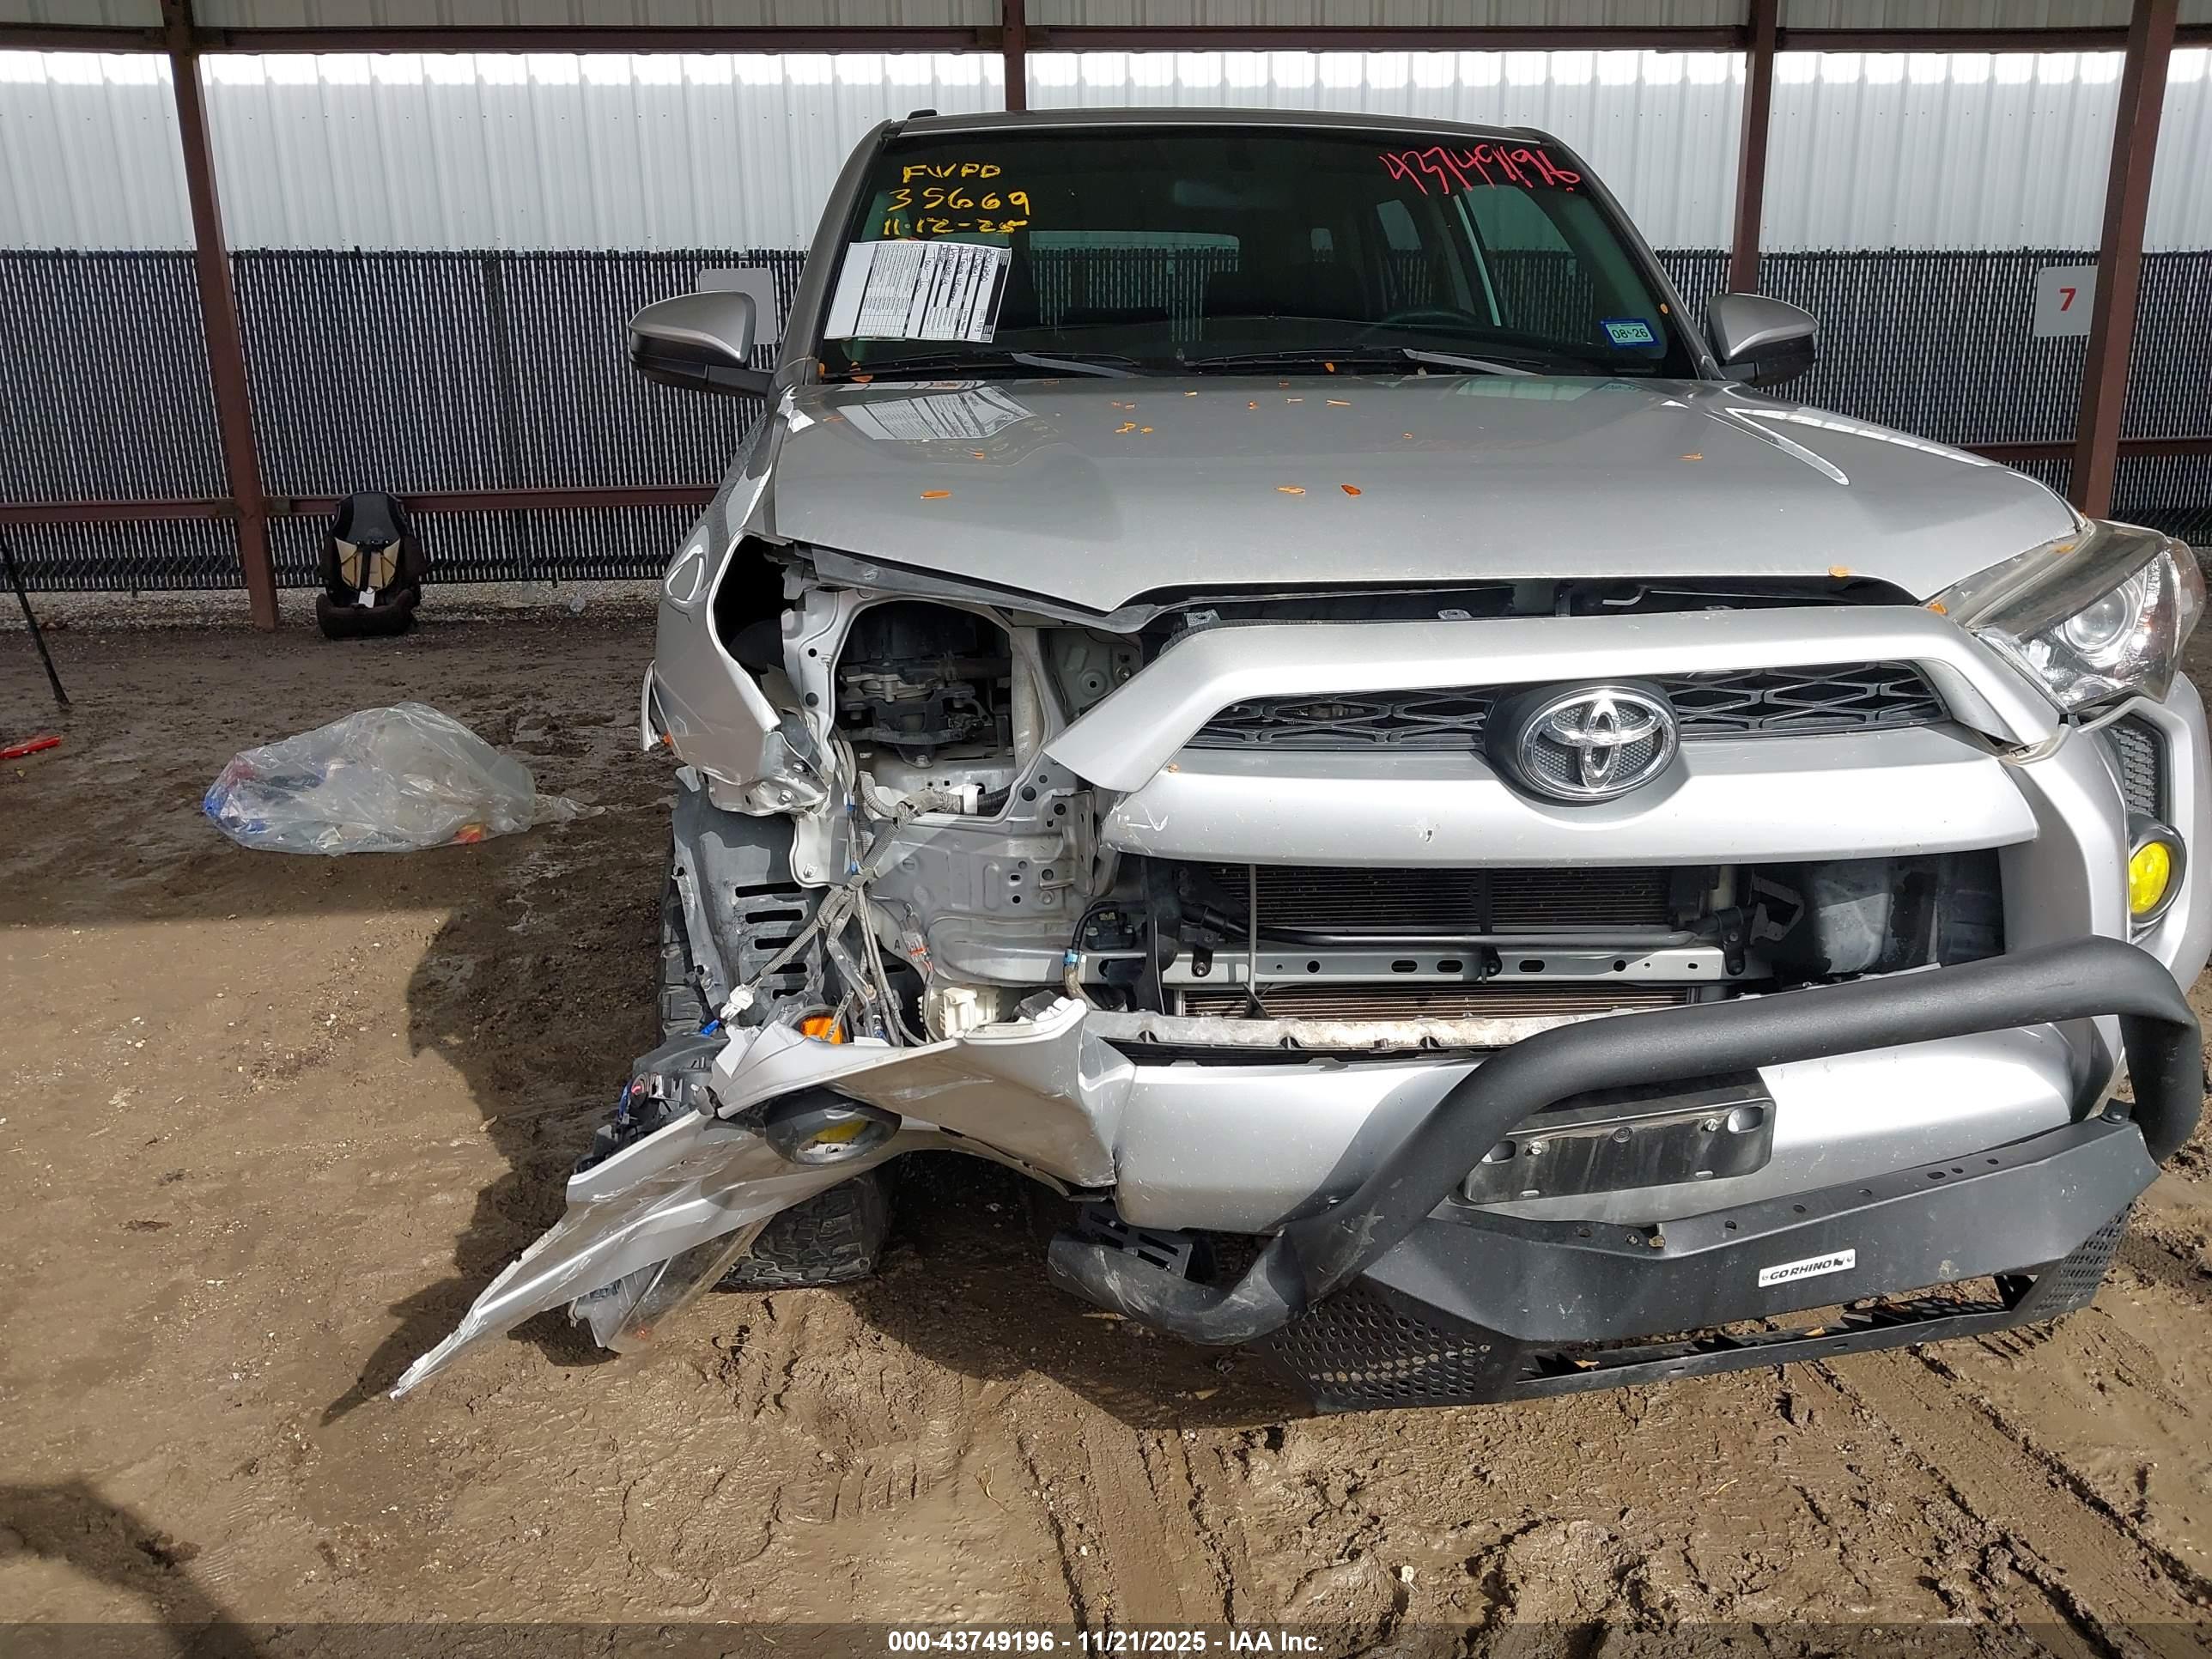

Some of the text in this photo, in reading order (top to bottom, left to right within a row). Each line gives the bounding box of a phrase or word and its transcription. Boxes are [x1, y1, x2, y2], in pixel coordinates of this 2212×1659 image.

[1378, 143, 1581, 195] 43749196
[2059, 288, 2076, 312] 7
[1612, 328, 1649, 339] 08 26
